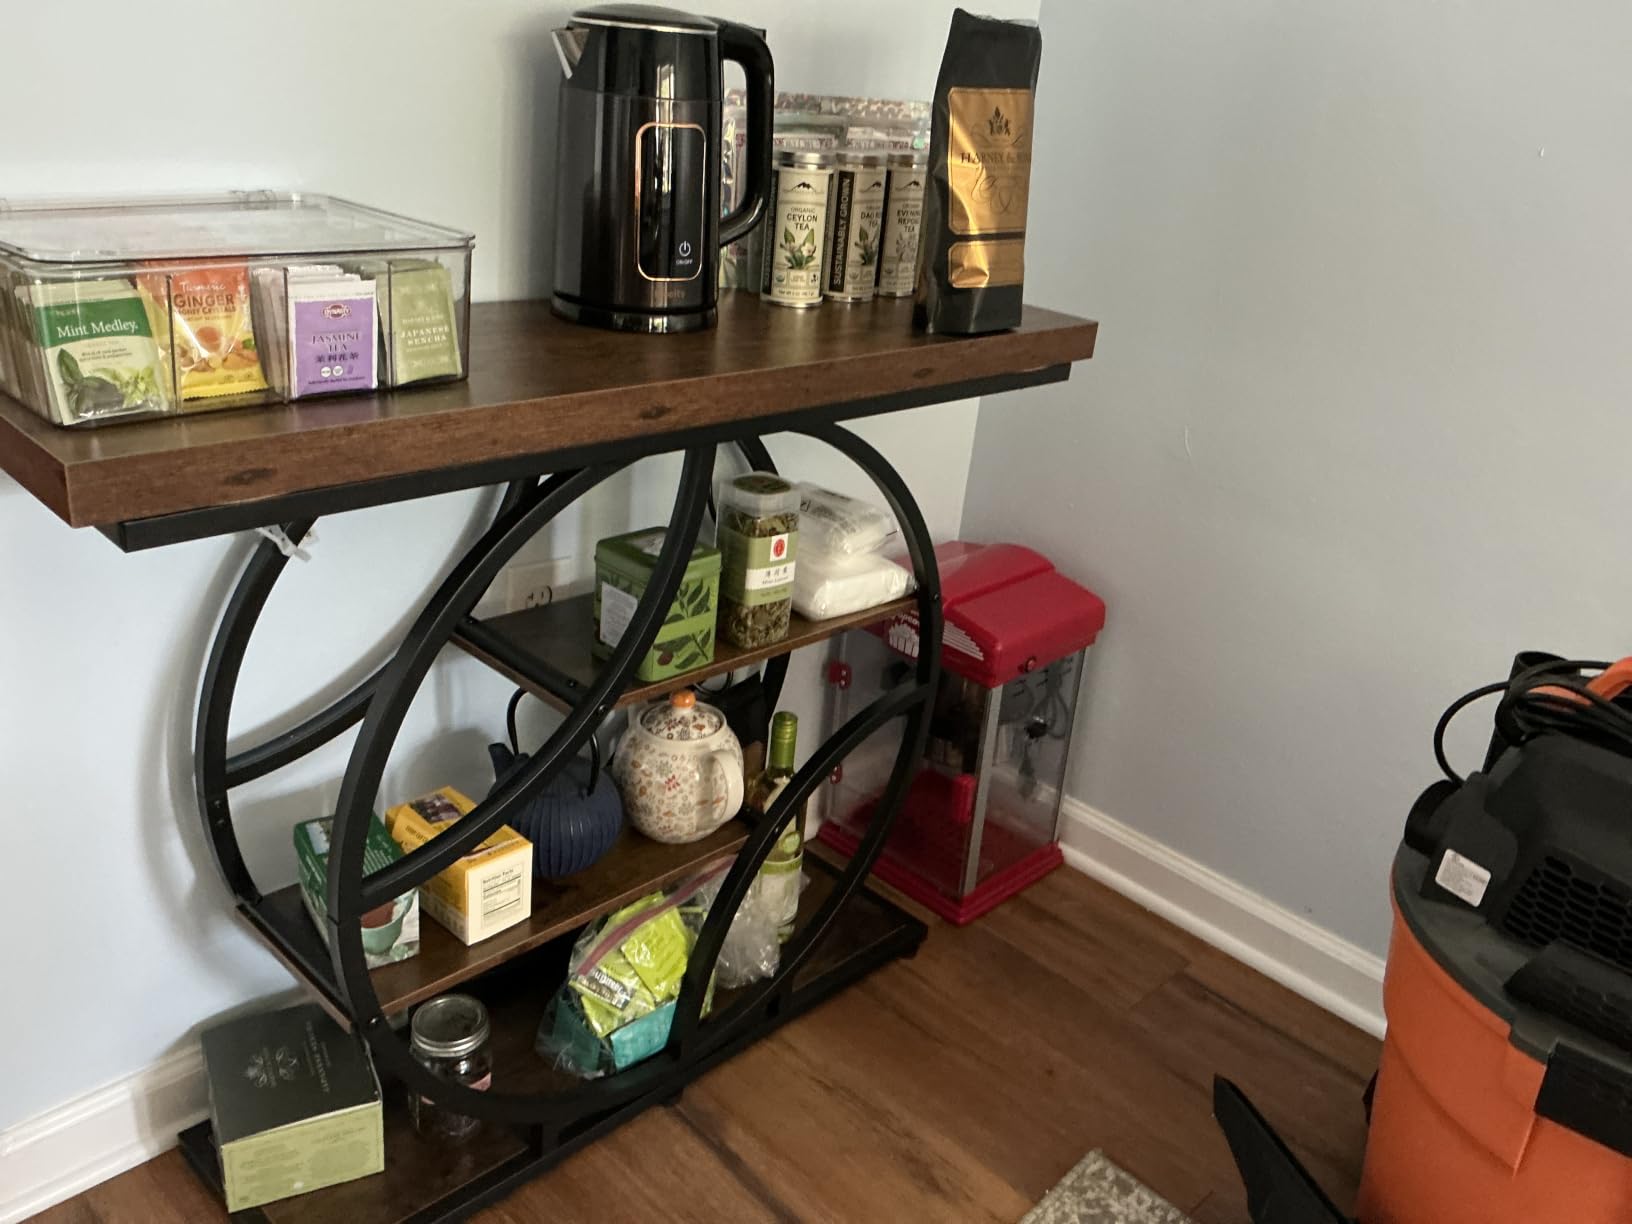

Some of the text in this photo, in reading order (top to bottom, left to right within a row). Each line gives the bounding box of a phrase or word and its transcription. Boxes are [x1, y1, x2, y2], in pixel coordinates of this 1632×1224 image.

[790, 206, 816, 214] ORGANIC
[786, 213, 818, 223] CEYLON
[794, 223, 810, 231] TEA
[904, 225, 915, 233] TEA
[833, 218, 850, 285] SUSTAINABLY
[174, 293, 235, 308] GINGER
[56, 324, 90, 338] Mint
[328, 343, 348, 353] TEA
